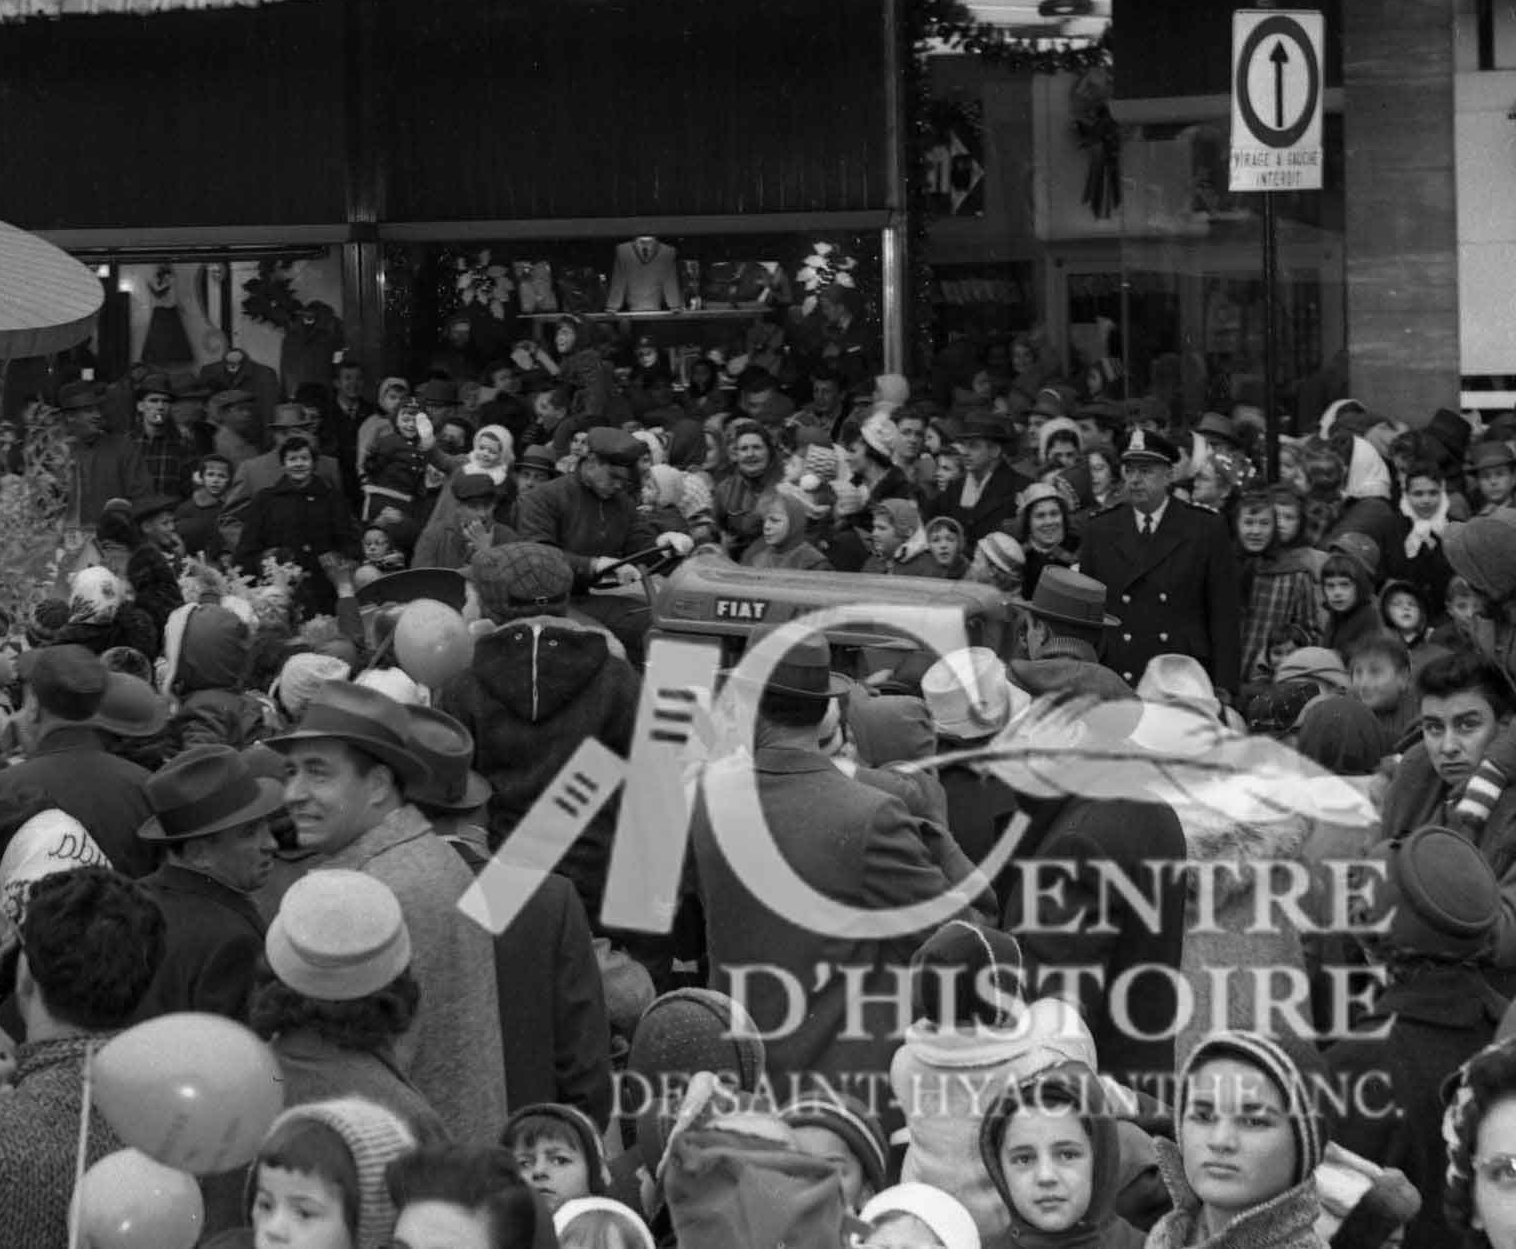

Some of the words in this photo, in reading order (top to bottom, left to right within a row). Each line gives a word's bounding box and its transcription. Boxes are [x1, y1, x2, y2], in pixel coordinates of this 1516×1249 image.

[1234, 151, 1269, 167] VIRAGE
[1256, 170, 1303, 187] INTERDIT
[716, 600, 766, 618] FIAT
